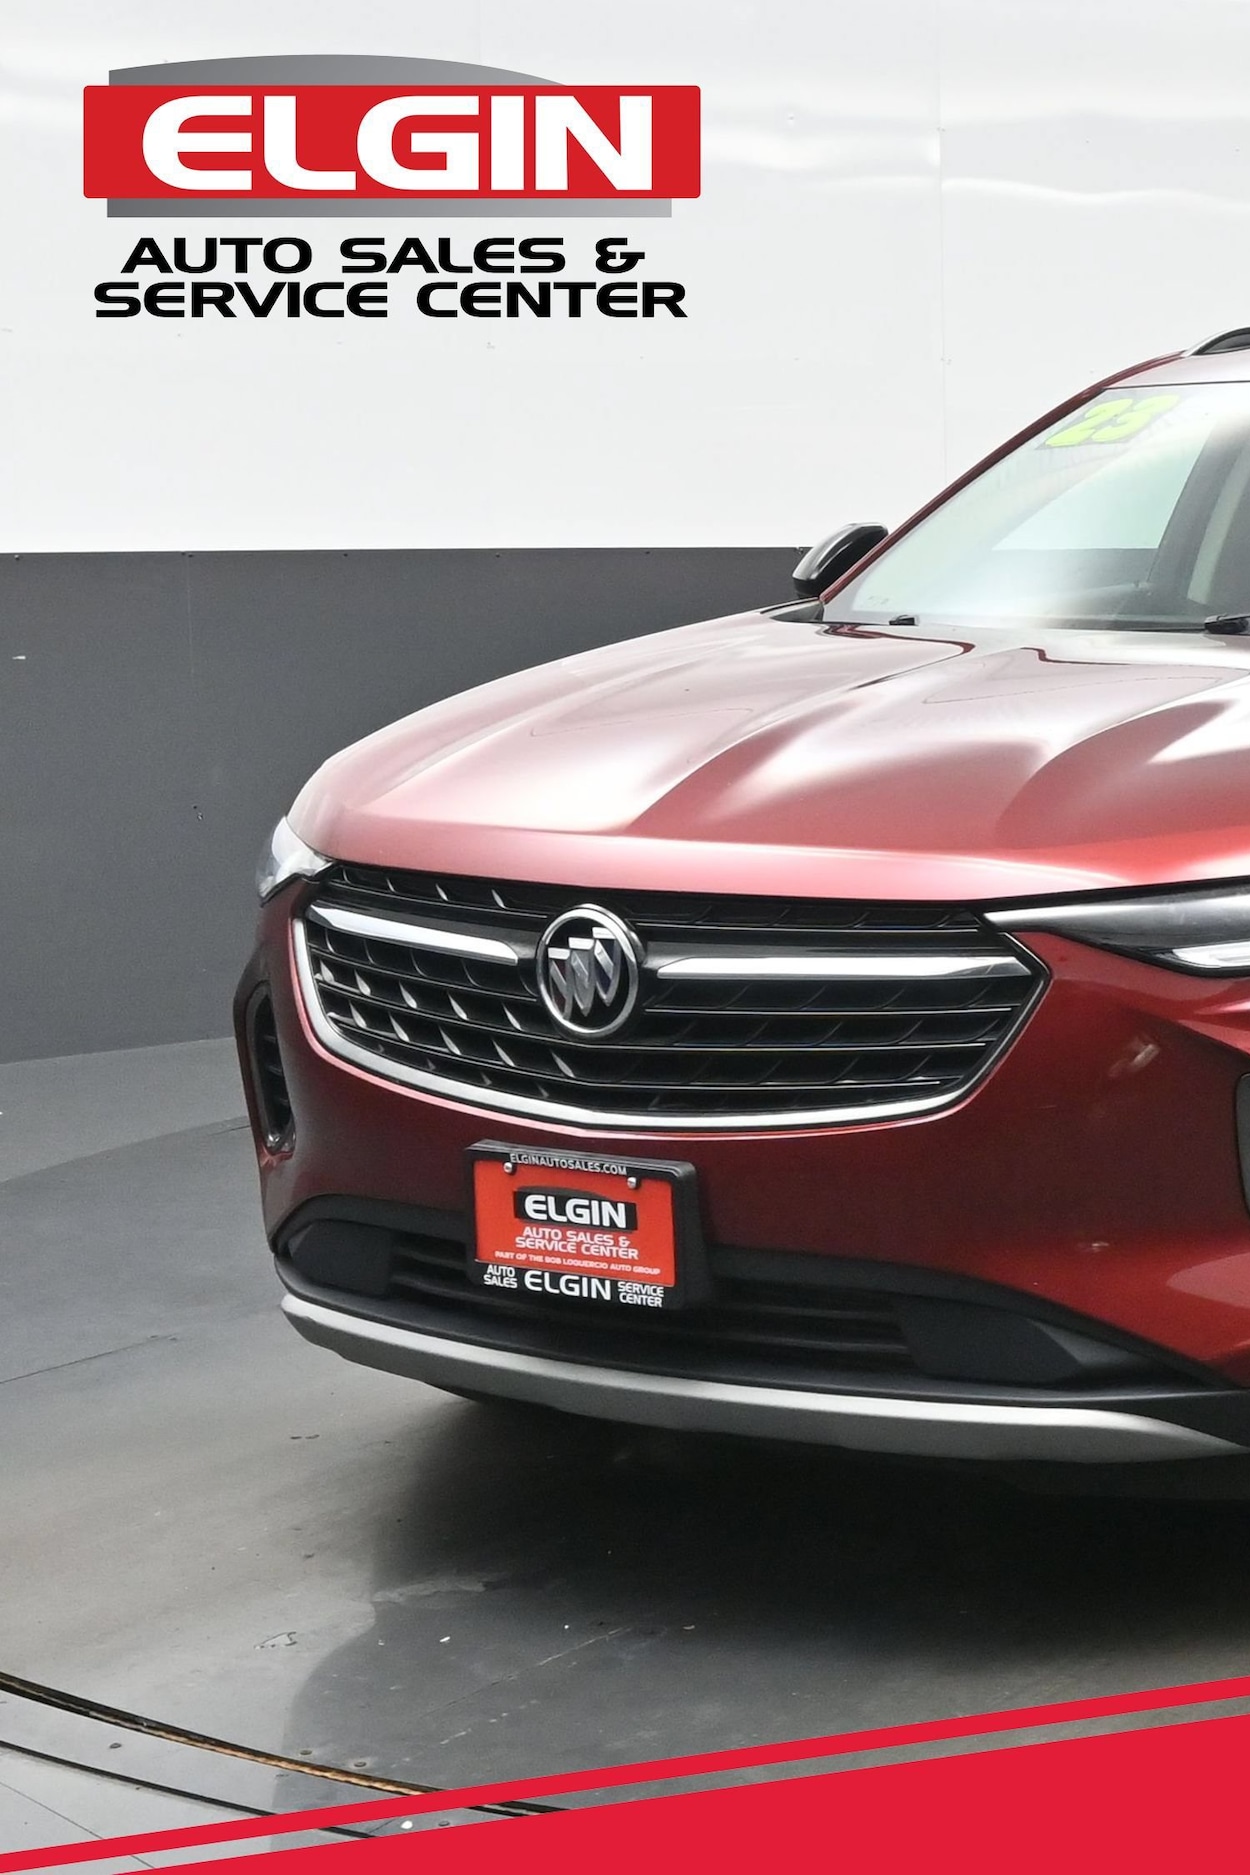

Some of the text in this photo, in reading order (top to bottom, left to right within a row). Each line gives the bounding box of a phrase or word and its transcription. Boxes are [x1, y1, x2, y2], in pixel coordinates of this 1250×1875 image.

[1044, 394, 1181, 447] 23
[509, 1153, 627, 1176] ELGINAUTOSALES.COM
[524, 1194, 627, 1229] ELGIN
[515, 1236, 639, 1260] SERVICE CENTER
[522, 1226, 631, 1248] AUTO SALES &
[486, 1264, 515, 1278] AUTO
[494, 1251, 515, 1260] PART
[528, 1254, 544, 1263] THE
[609, 1264, 632, 1272] AUTO
[632, 1266, 661, 1275] GROUP
[483, 1274, 518, 1289] SALES
[524, 1270, 612, 1301] ELGIN
[617, 1281, 665, 1297] SERVICE
[618, 1292, 663, 1308] CENTER
